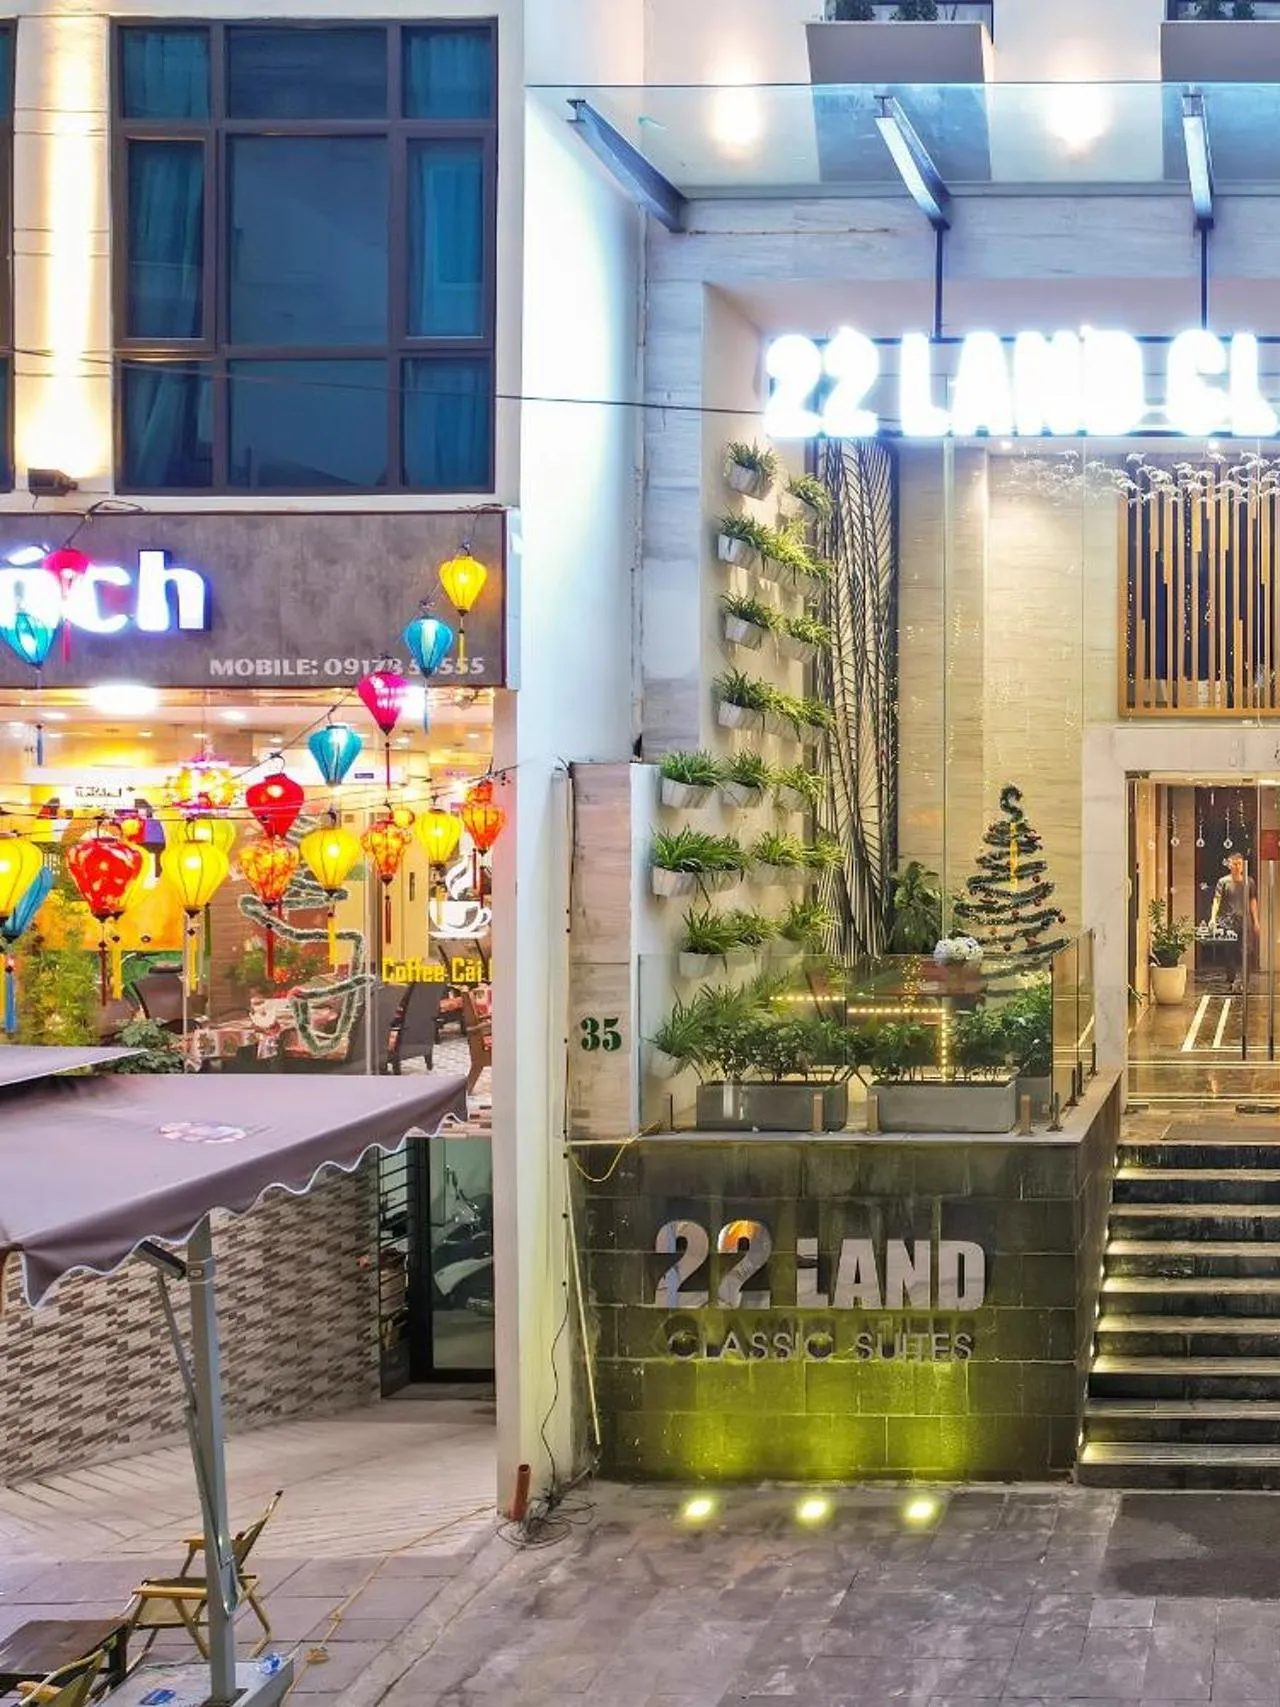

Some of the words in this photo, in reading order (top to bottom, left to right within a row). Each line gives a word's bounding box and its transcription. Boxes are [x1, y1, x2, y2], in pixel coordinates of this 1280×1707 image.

[764, 327, 880, 437] 22
[900, 328, 1145, 437] LAND
[209, 658, 318, 676] MOBILE:
[382, 957, 446, 982] Coffee
[580, 1016, 622, 1052] 35
[654, 1219, 772, 1310] 22
[797, 1238, 986, 1310] LAND
[667, 1330, 834, 1362] CLASSIC
[855, 1331, 974, 1362] SUITES
